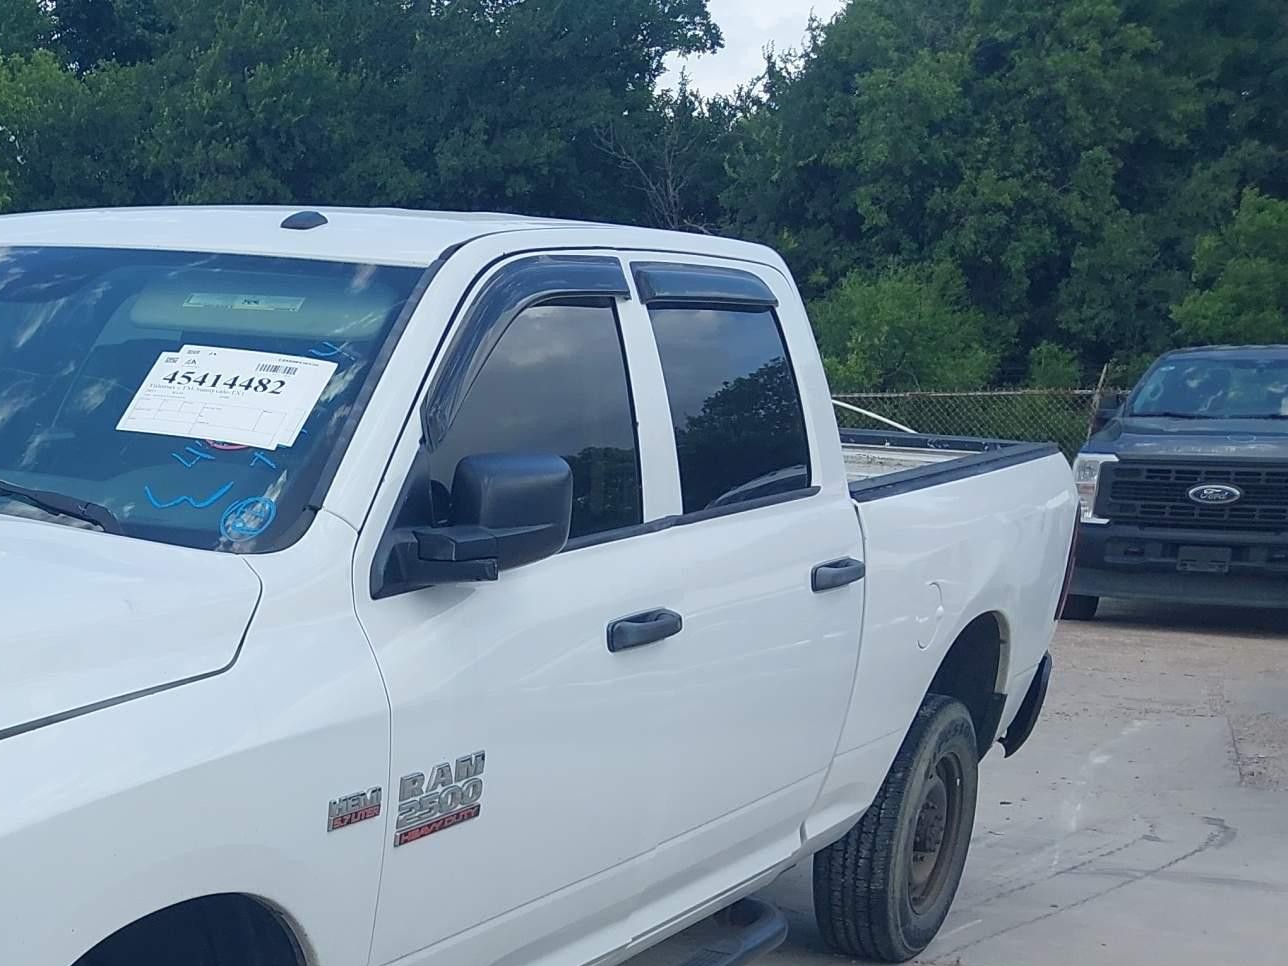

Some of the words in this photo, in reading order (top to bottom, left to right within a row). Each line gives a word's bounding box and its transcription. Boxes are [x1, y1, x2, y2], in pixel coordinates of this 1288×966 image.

[162, 370, 286, 395] 45414482
[399, 750, 486, 802] RAM
[329, 787, 382, 816] HEMI
[350, 806, 381, 823] LITER
[396, 777, 484, 829] 2500
[400, 820, 443, 843] HEAVY
[444, 808, 478, 827] DUTY
